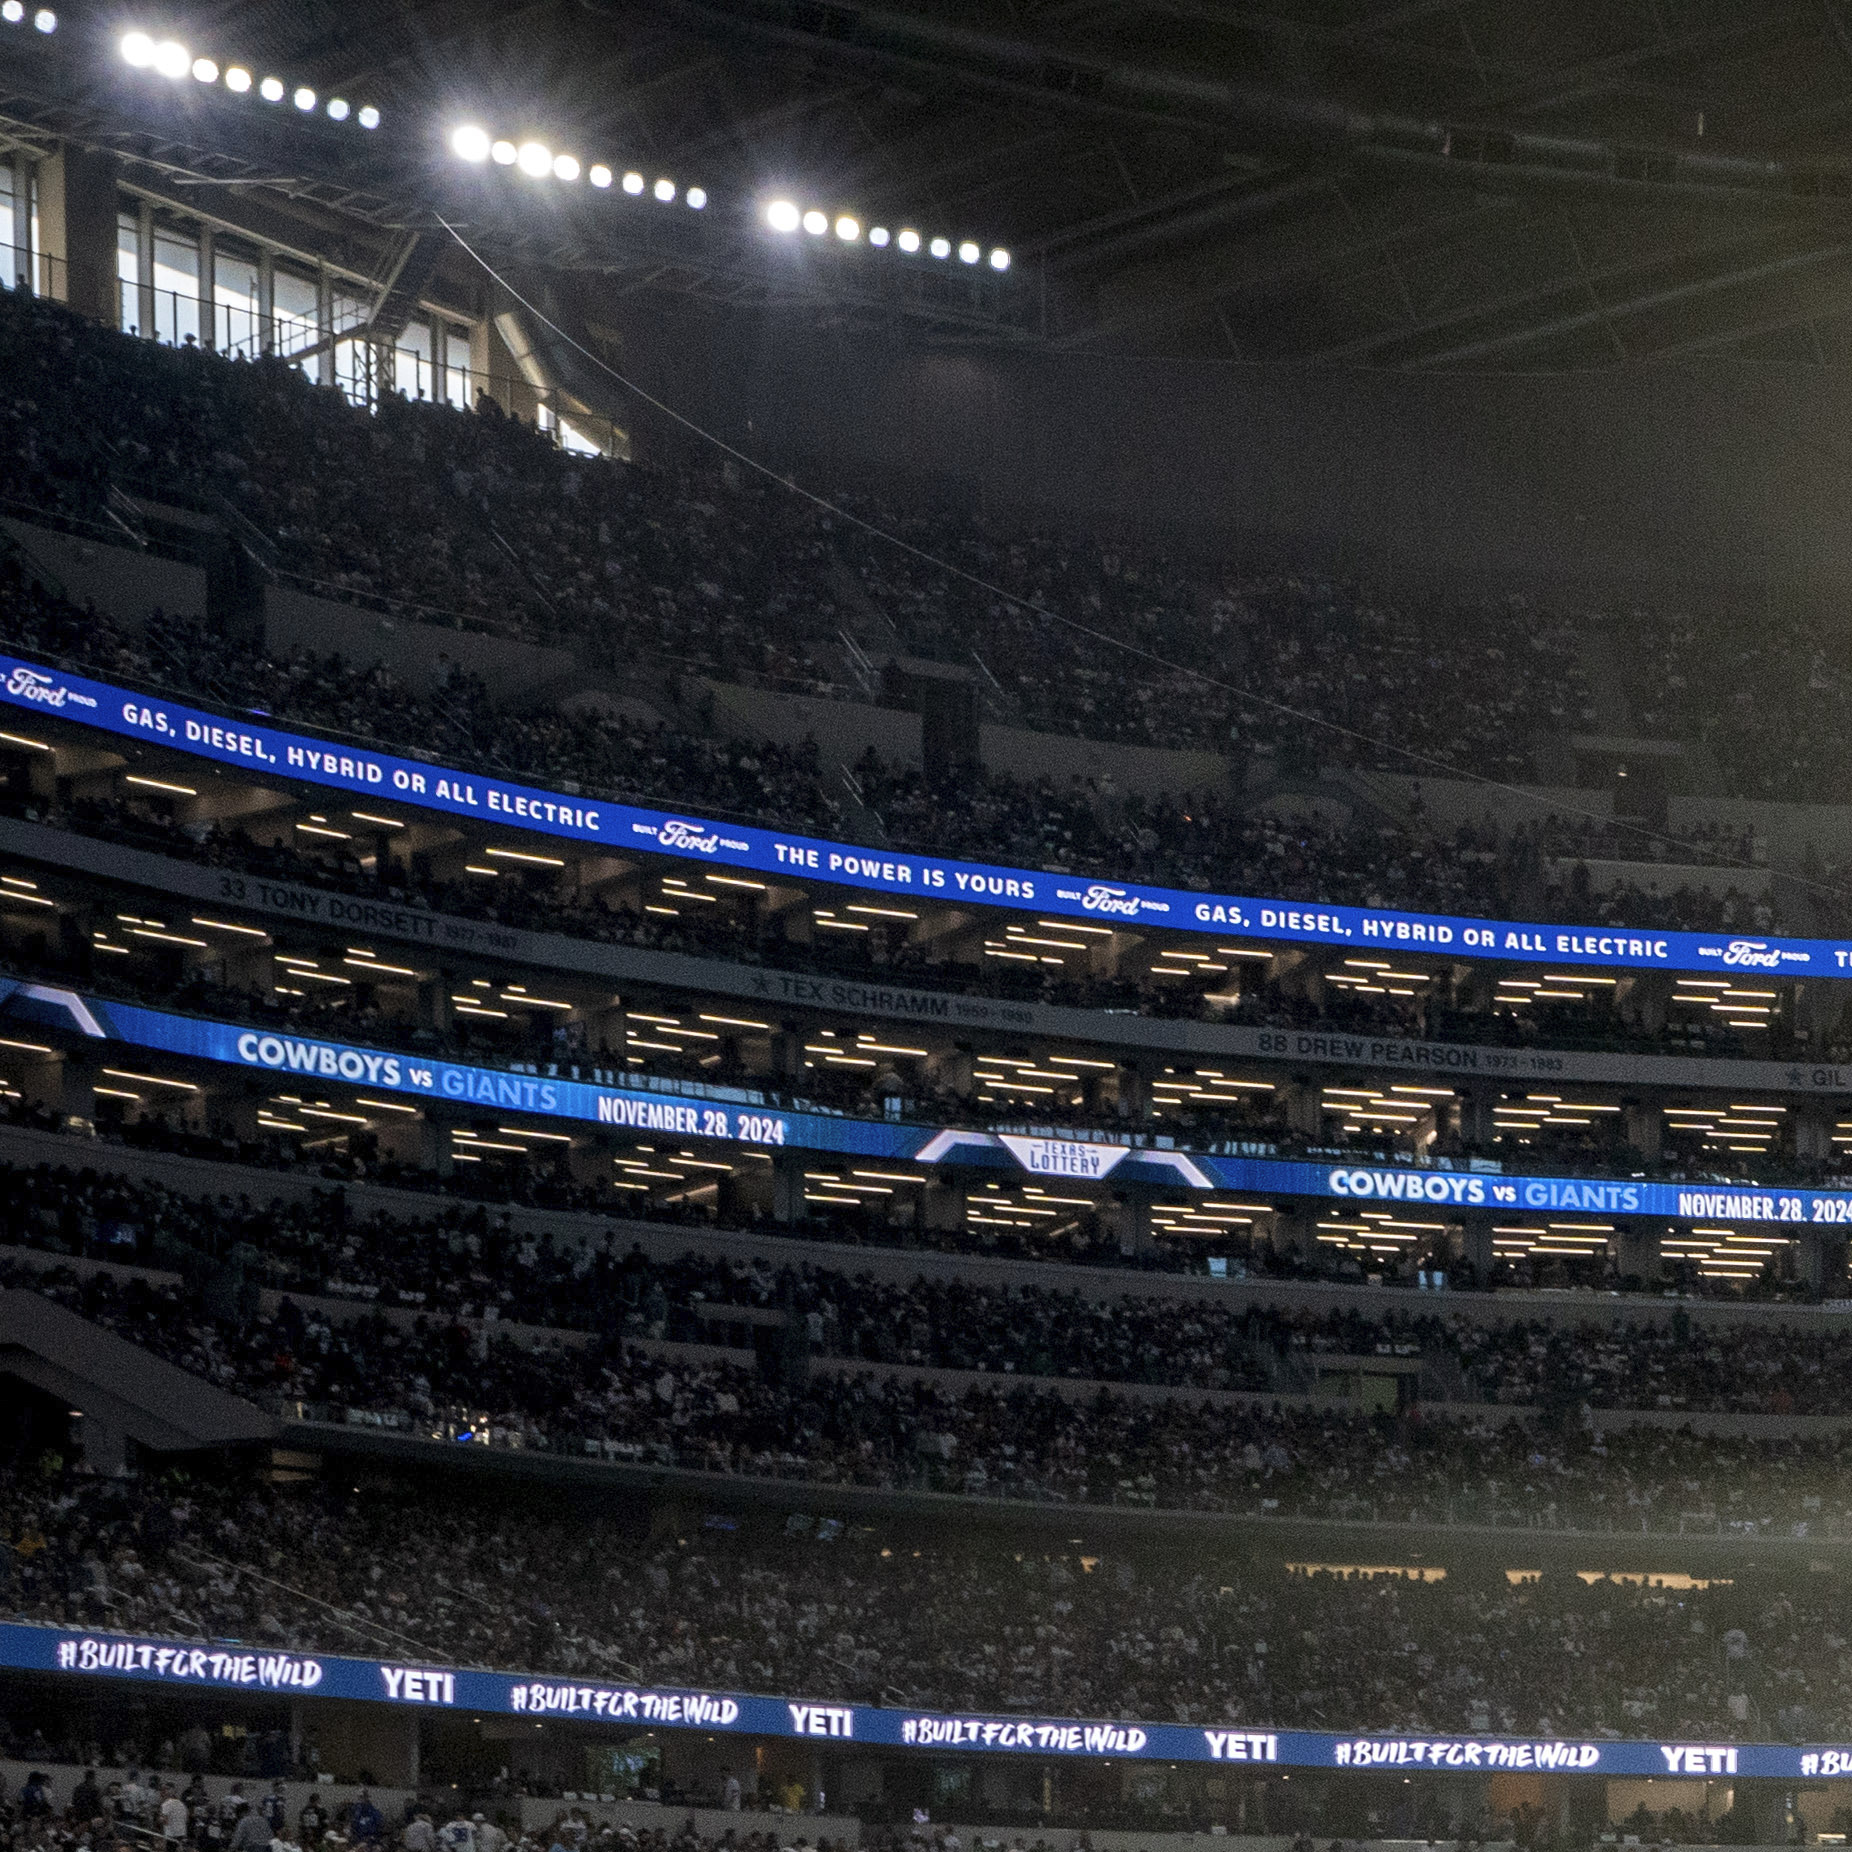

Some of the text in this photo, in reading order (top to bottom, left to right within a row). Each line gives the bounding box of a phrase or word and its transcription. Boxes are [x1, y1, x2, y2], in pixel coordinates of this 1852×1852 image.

[6, 668, 67, 707] Ford
[123, 703, 600, 831] GAS, DIESEL, HYBRID OR ALL ELECTRIC
[658, 820, 719, 854] Ford
[774, 843, 1035, 899] THE POWER IS YOURS
[258, 884, 320, 914] TONY
[329, 902, 434, 938] DORSETT
[1081, 885, 1140, 916] Ford
[1195, 903, 1668, 958] GAS, DIESEL, HYBRID OR ALL ELECTRIC
[1722, 941, 1781, 967] Ford
[780, 974, 824, 1003] TEX
[832, 985, 948, 1018] SCHRAMM
[1297, 1037, 1363, 1059] DREW
[1371, 1044, 1477, 1067] PEARSON
[236, 1031, 401, 1087] COWBOYS
[441, 1067, 558, 1112] GIANTS
[737, 1114, 785, 1146] 2024
[1813, 1069, 1847, 1087] GIL
[1030, 1150, 1100, 1175] LOTTERY
[1044, 1141, 1086, 1157] TEXAS
[1328, 1167, 1486, 1204] COWBOYS
[1525, 1181, 1641, 1211] GIANTS
[380, 1666, 455, 1704] YETI
[788, 1704, 854, 1737] YETI
[1204, 1731, 1278, 1761] YETI
[1660, 1746, 1739, 1774] YETI
